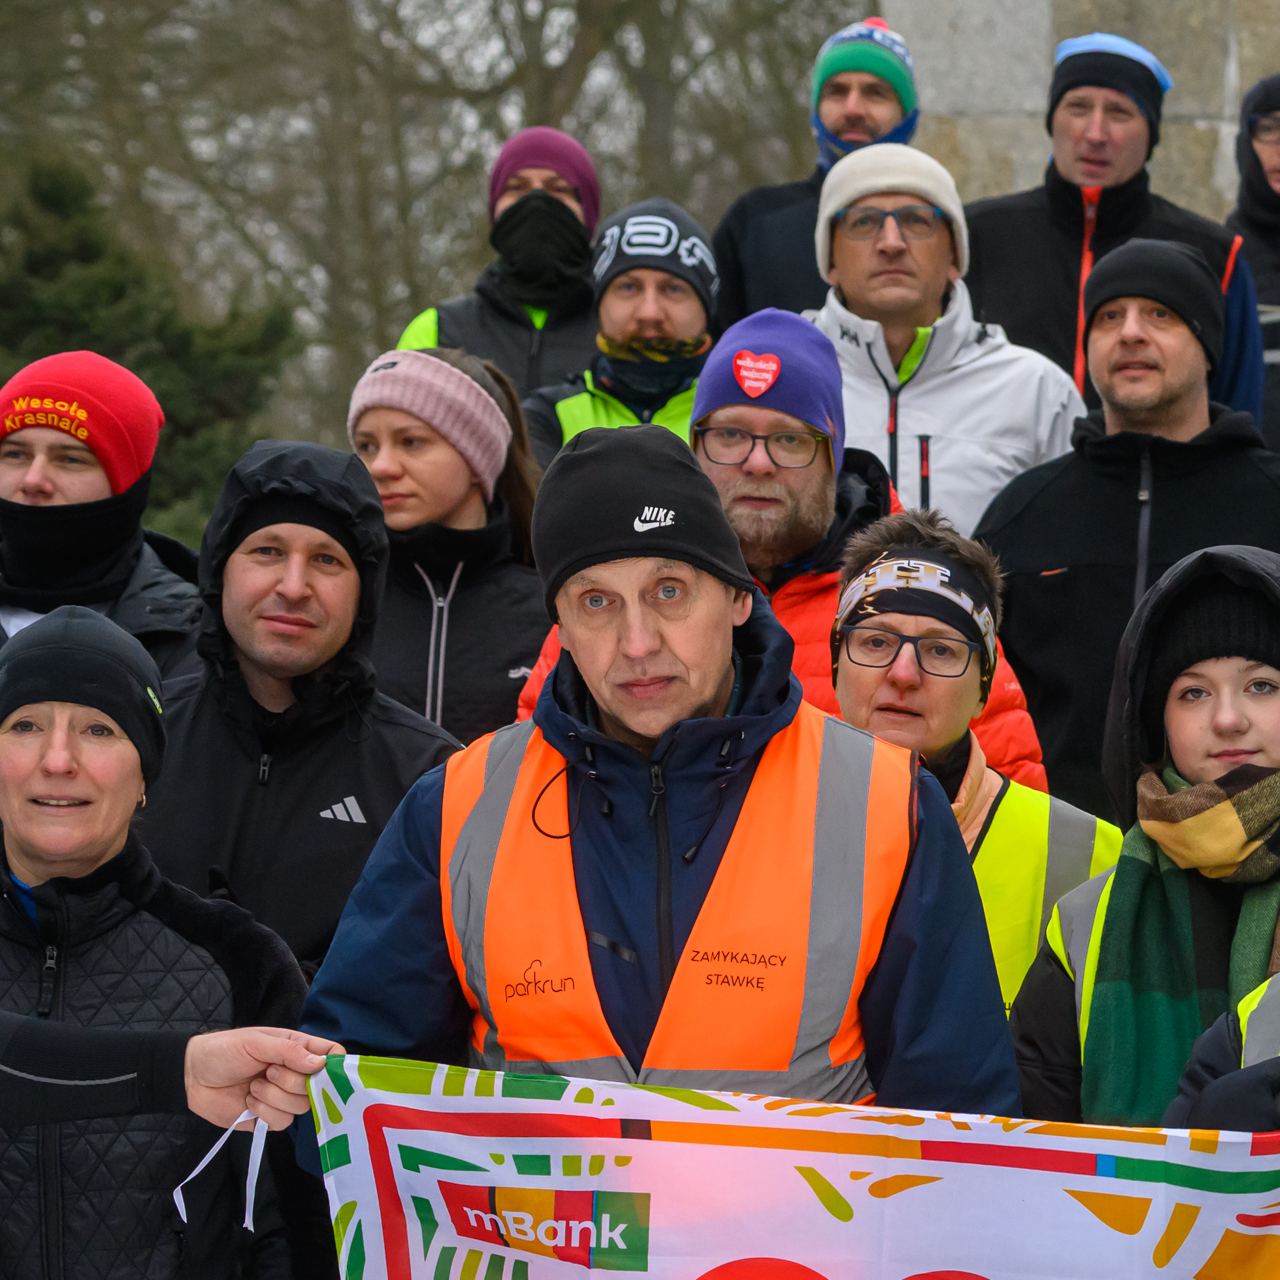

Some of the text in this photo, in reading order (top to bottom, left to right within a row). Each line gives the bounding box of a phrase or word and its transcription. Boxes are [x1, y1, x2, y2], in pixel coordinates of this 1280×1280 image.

[4, 412, 89, 440] Krasnale
[641, 506, 676, 526] NIKE
[690, 949, 787, 969] ZAMYKAJĄCY
[504, 965, 575, 1003] parkrun
[705, 973, 766, 992] STAWKĘ
[463, 1206, 629, 1250] mBank
